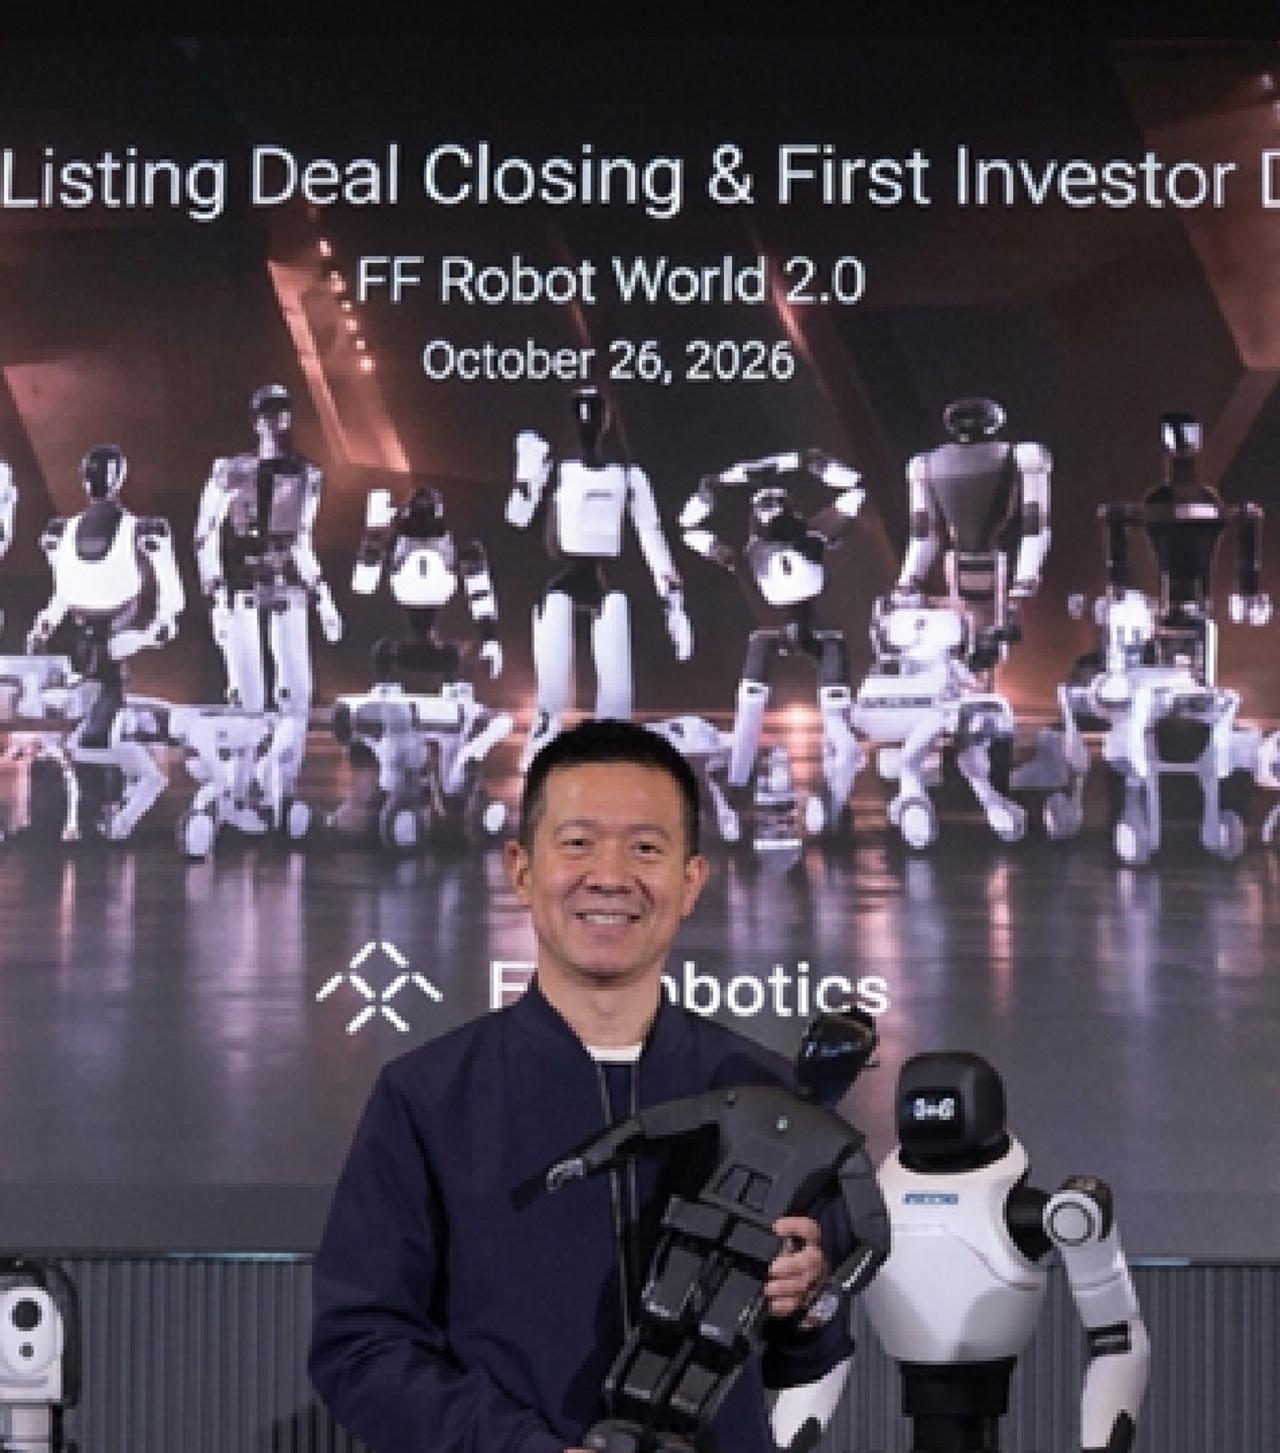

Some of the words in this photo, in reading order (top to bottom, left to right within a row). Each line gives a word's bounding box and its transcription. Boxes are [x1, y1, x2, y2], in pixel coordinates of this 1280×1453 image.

[3, 149, 225, 219] Listing
[252, 144, 399, 205] Deal
[425, 144, 681, 219] Closing
[708, 145, 755, 205] &
[778, 145, 931, 205] First
[957, 147, 1236, 208] Investor
[358, 256, 422, 303] FF
[442, 255, 597, 303] Robot
[611, 255, 766, 303] World
[784, 256, 866, 304] 2.0
[422, 338, 597, 383] October
[609, 340, 673, 391] 26,
[685, 340, 795, 383] 2026
